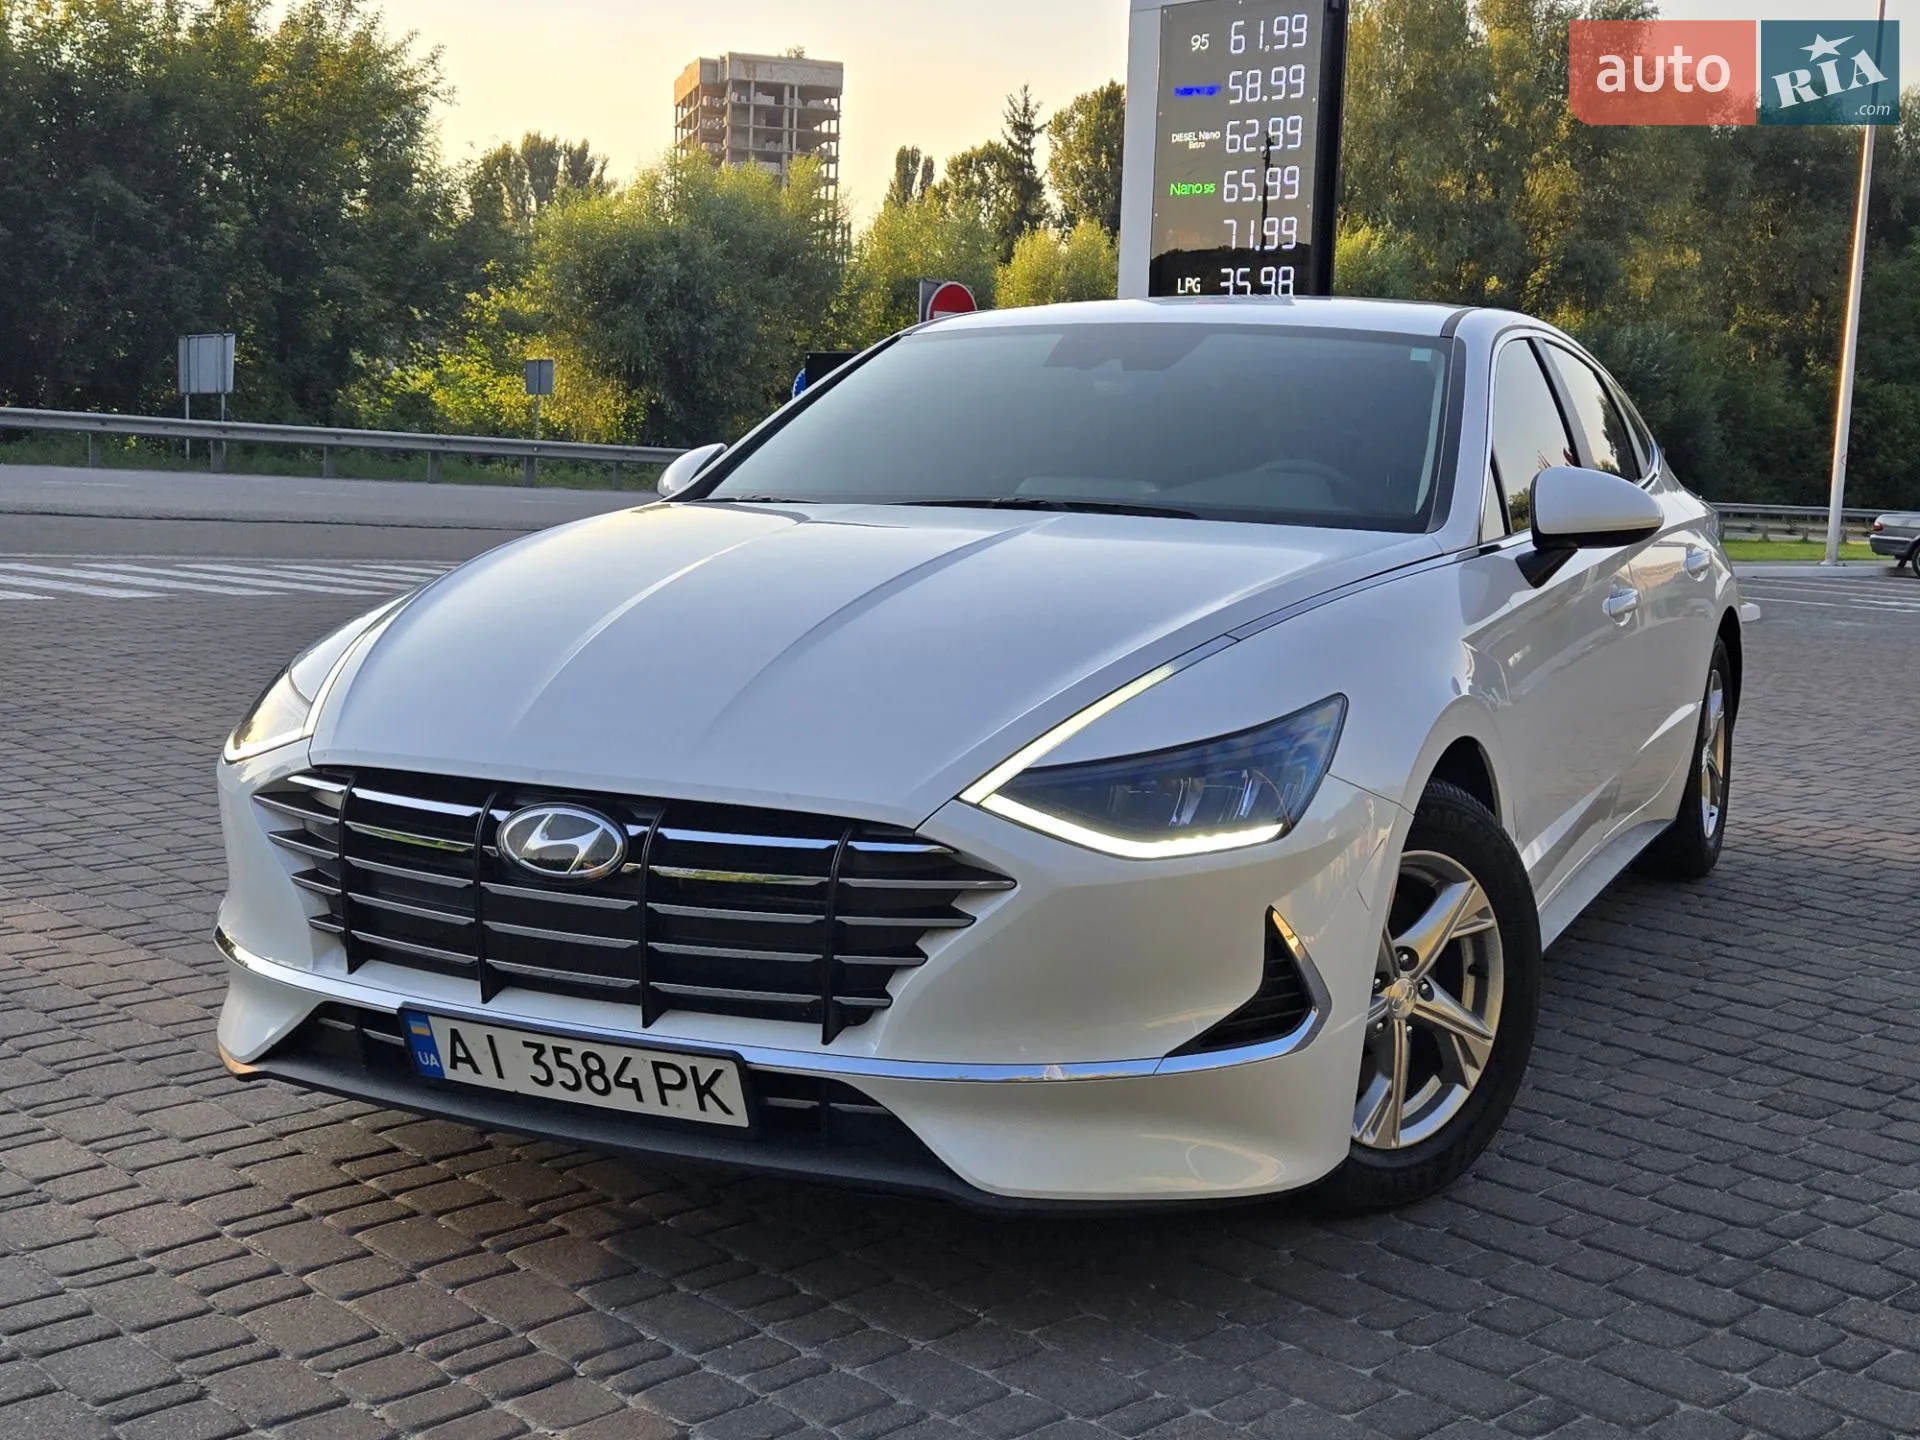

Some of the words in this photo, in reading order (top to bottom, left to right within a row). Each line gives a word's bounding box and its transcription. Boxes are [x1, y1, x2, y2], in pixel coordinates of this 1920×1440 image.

[1191, 33, 1209, 51] 95
[1230, 14, 1307, 54] 61.99
[1229, 64, 1305, 104] 58.99
[1171, 131, 1197, 143] DIESEL
[1198, 129, 1220, 141] Nano
[1225, 115, 1302, 153] 62.99
[1170, 183, 1202, 195] Nano
[1203, 183, 1216, 194] 95
[1223, 165, 1300, 203] 65.99
[1223, 216, 1298, 250] 71.99
[1177, 277, 1201, 294] LPG
[417, 1051, 440, 1068] UA
